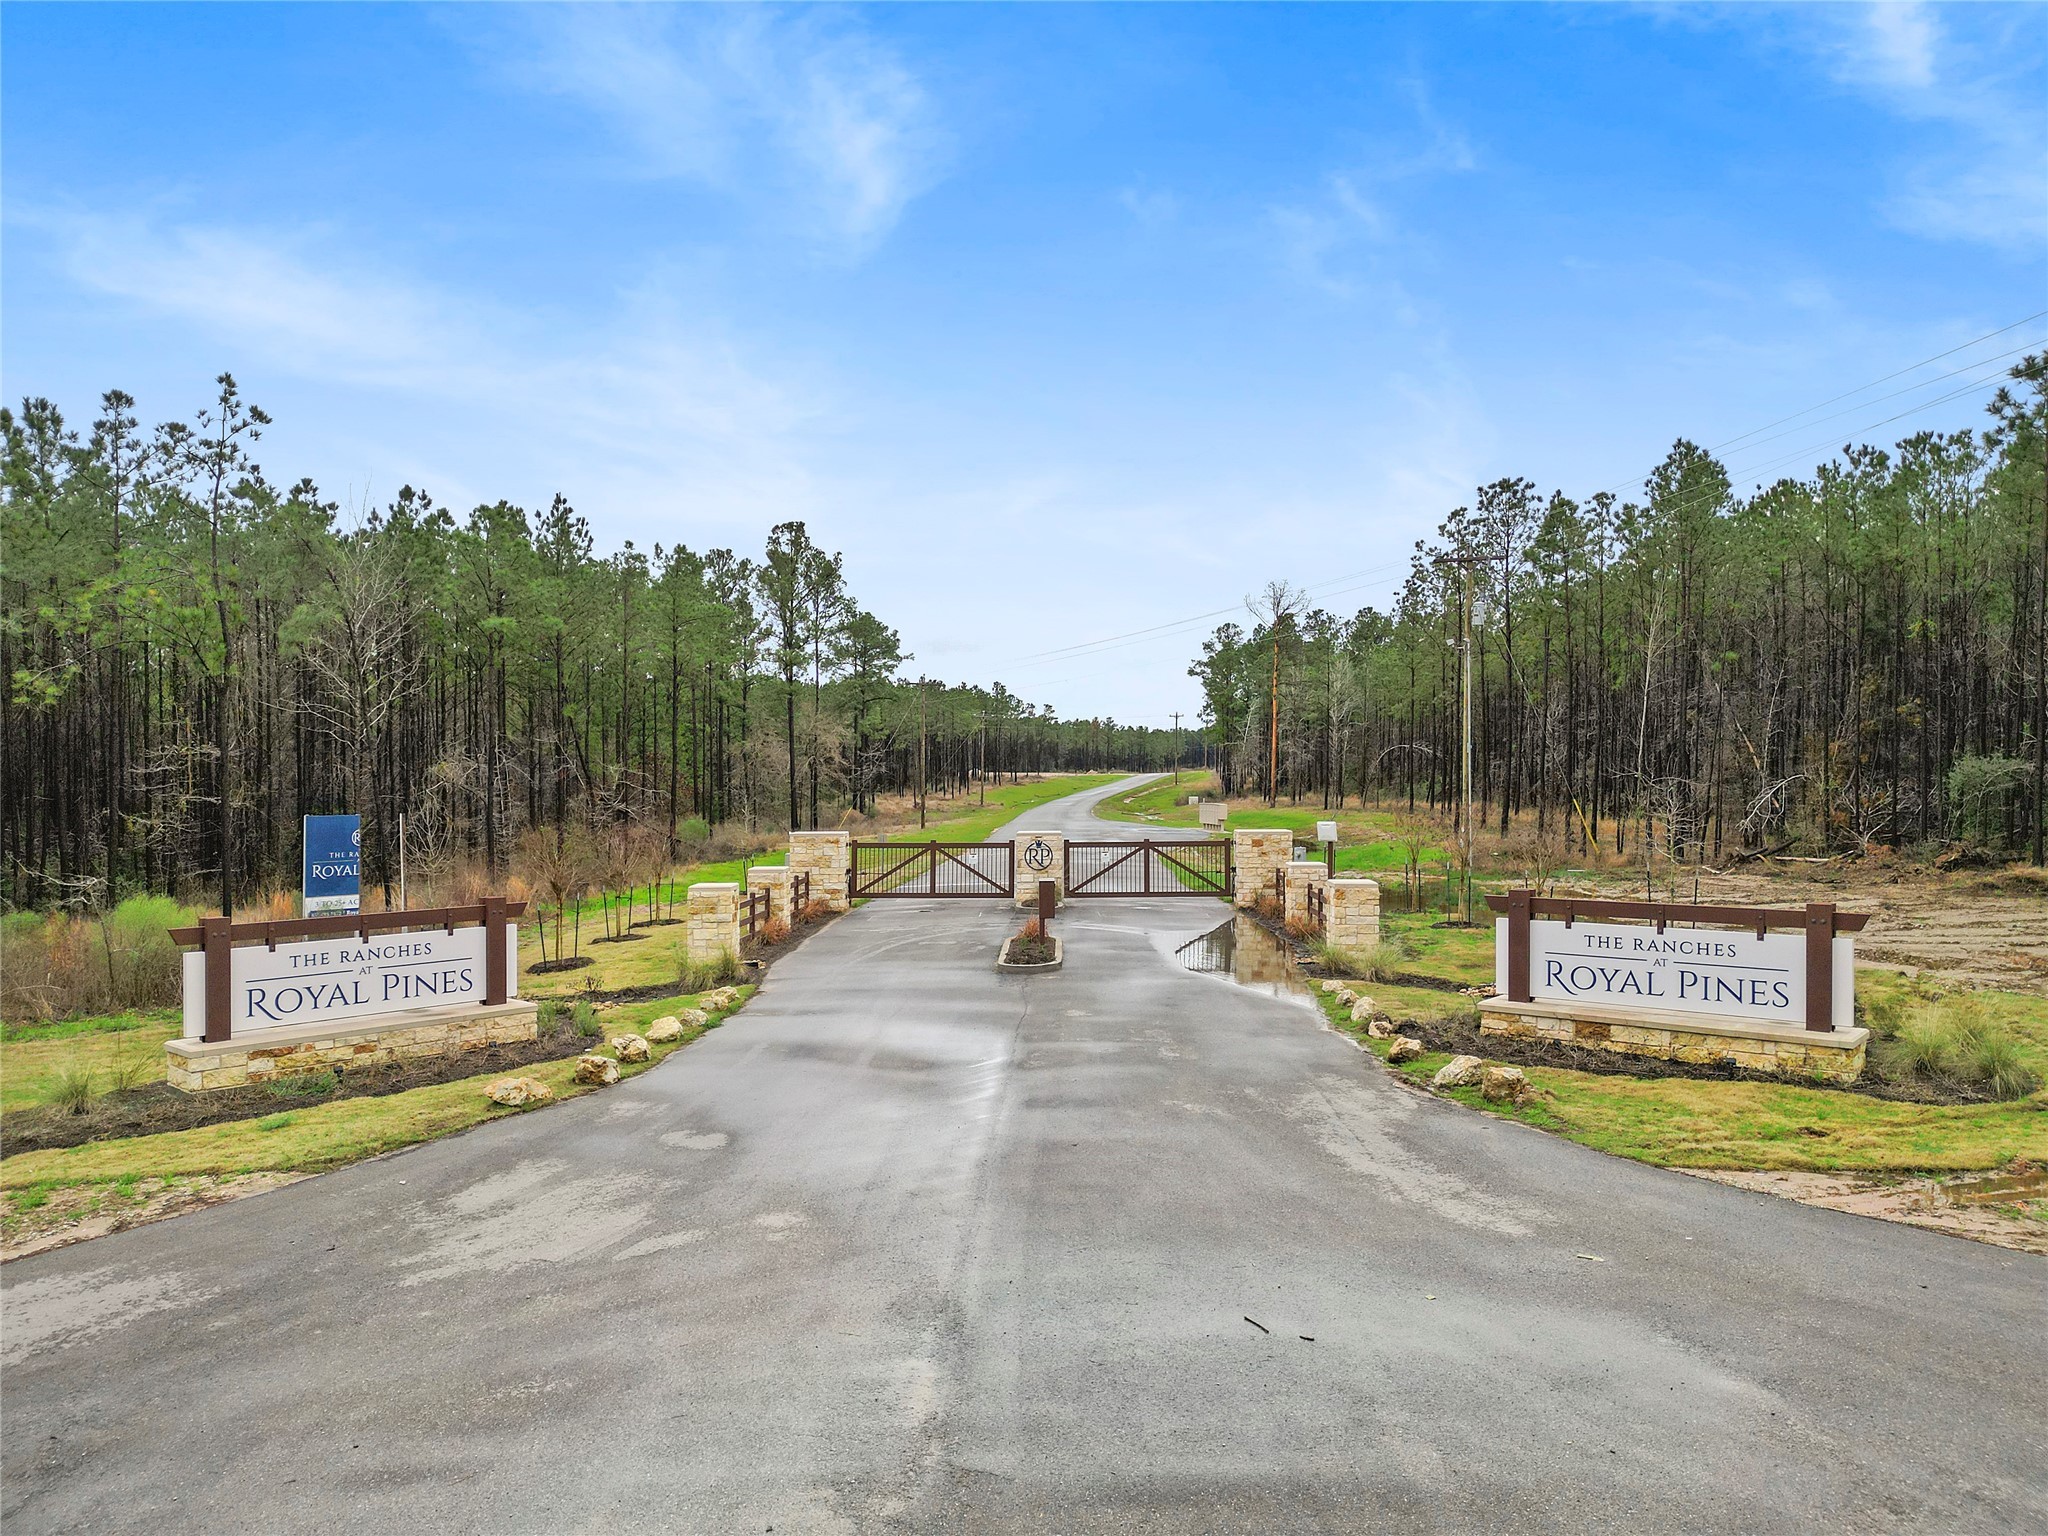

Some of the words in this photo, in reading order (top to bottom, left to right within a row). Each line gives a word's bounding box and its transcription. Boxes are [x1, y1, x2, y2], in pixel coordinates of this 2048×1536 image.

[1029, 848, 1050, 867] RP
[312, 864, 360, 880] ROYAL
[289, 951, 331, 969] THE
[340, 942, 432, 964] RANCHES
[1584, 934, 1623, 950] THE
[1633, 938, 1737, 958] RANCHES
[358, 965, 374, 975] AT
[1653, 958, 1668, 967] AT
[1544, 959, 1665, 996] ROYAL
[1678, 969, 1789, 1008] PINES
[245, 981, 371, 1021] ROYAL
[382, 968, 473, 1001] PINES
